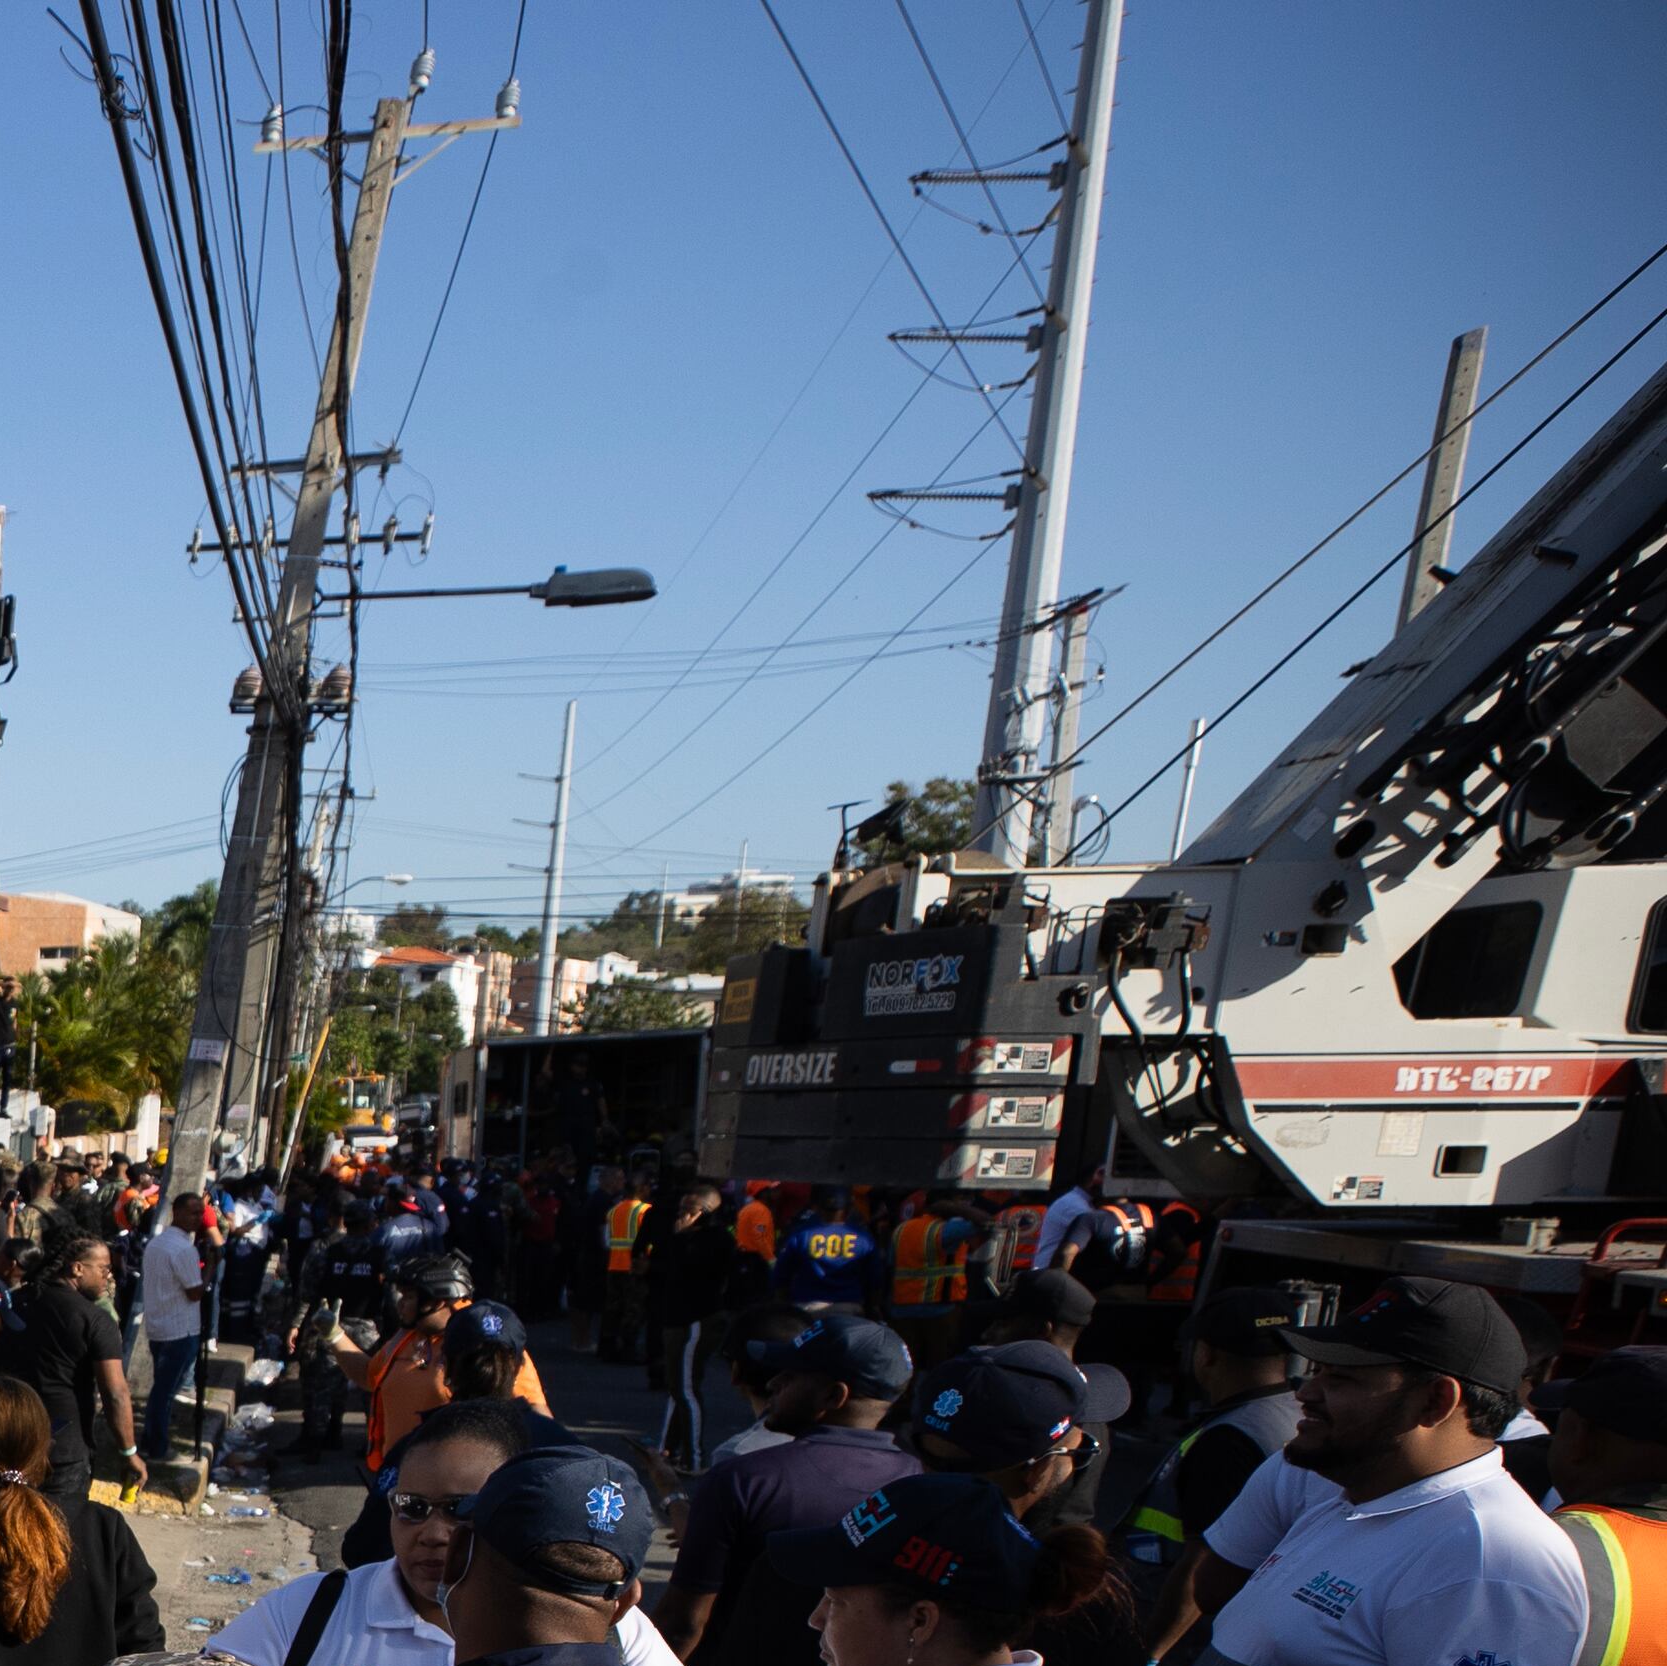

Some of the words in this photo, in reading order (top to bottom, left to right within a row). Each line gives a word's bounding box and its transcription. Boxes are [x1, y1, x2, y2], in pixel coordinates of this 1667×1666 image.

[868, 955, 964, 989] NORFOX
[747, 1053, 838, 1086] OVERSIZE
[809, 1234, 858, 1259] COE
[587, 1519, 618, 1534] CRUE
[892, 1535, 955, 1585] 911
